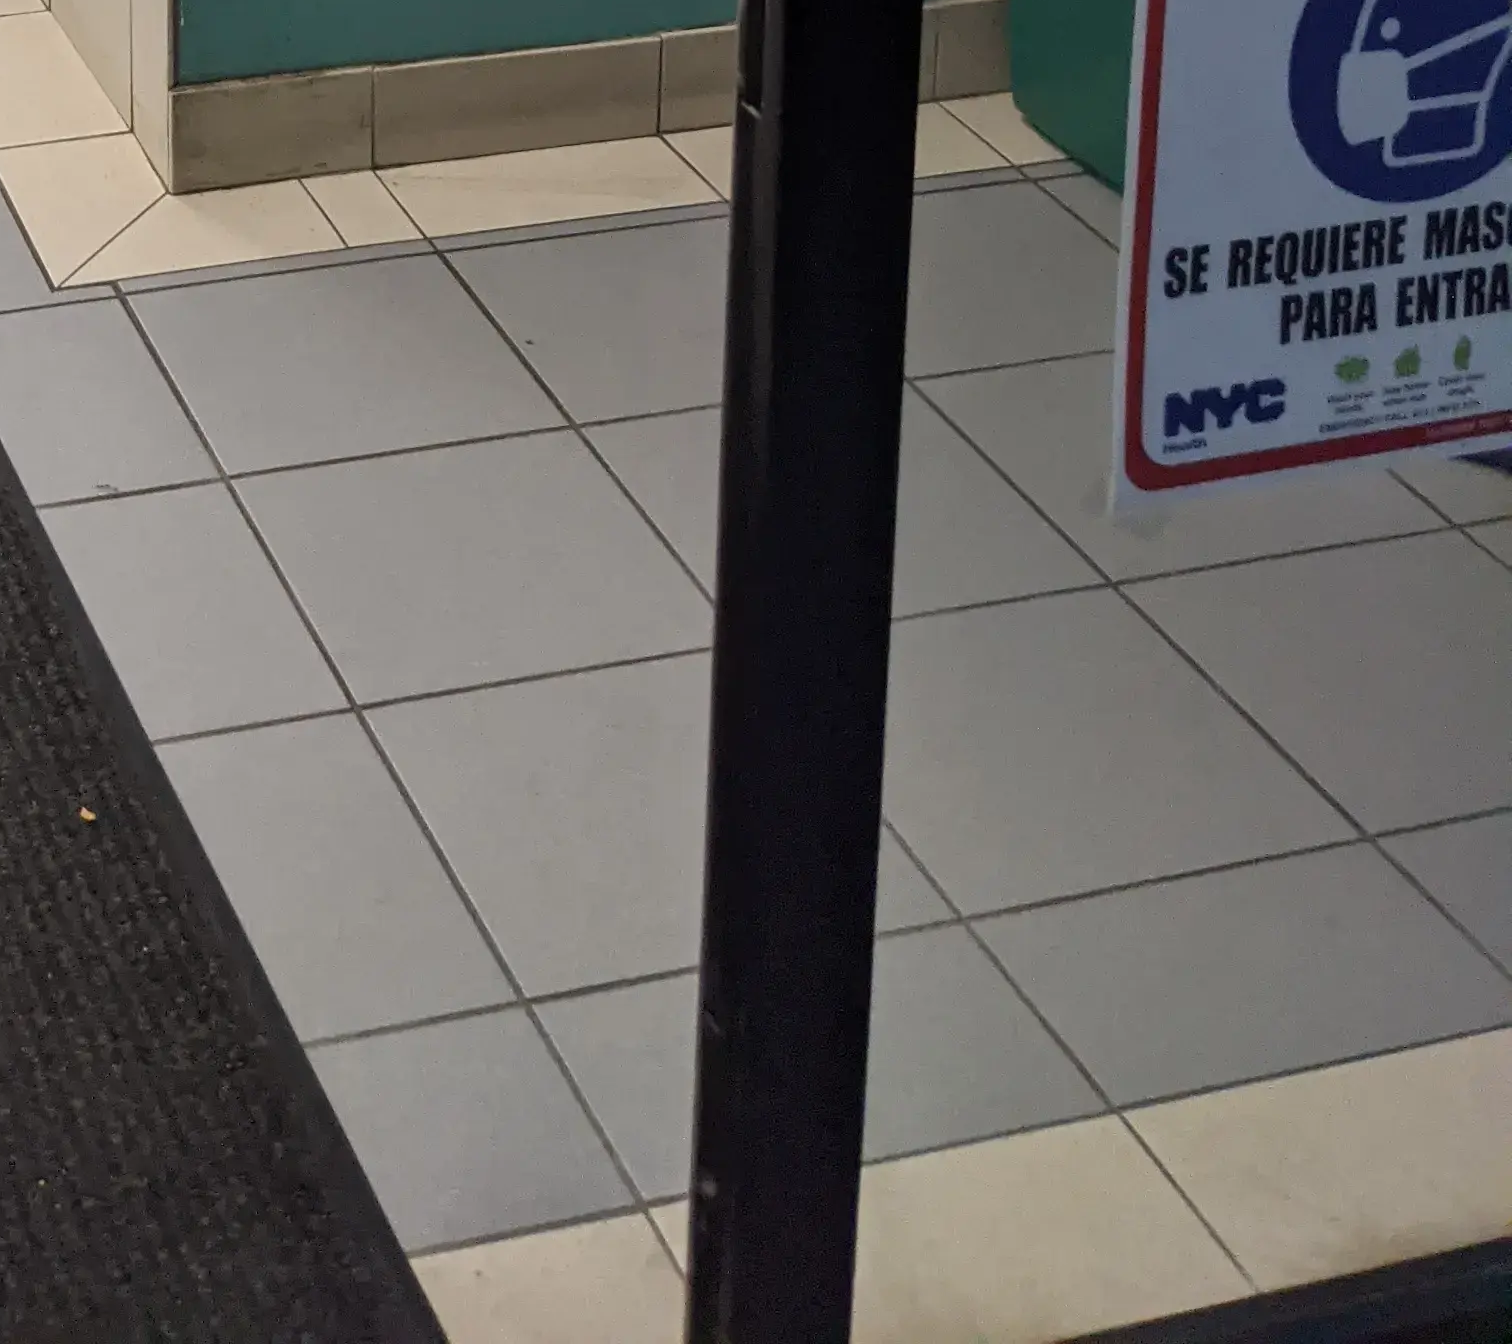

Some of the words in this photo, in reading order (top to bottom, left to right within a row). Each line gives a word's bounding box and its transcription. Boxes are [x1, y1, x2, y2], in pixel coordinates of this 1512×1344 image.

[1163, 243, 1211, 299] SE
[1226, 213, 1408, 291] REQUIERE
[1422, 200, 1512, 261] MAS
[1279, 281, 1378, 346] PARA
[1163, 377, 1287, 438] NYC
